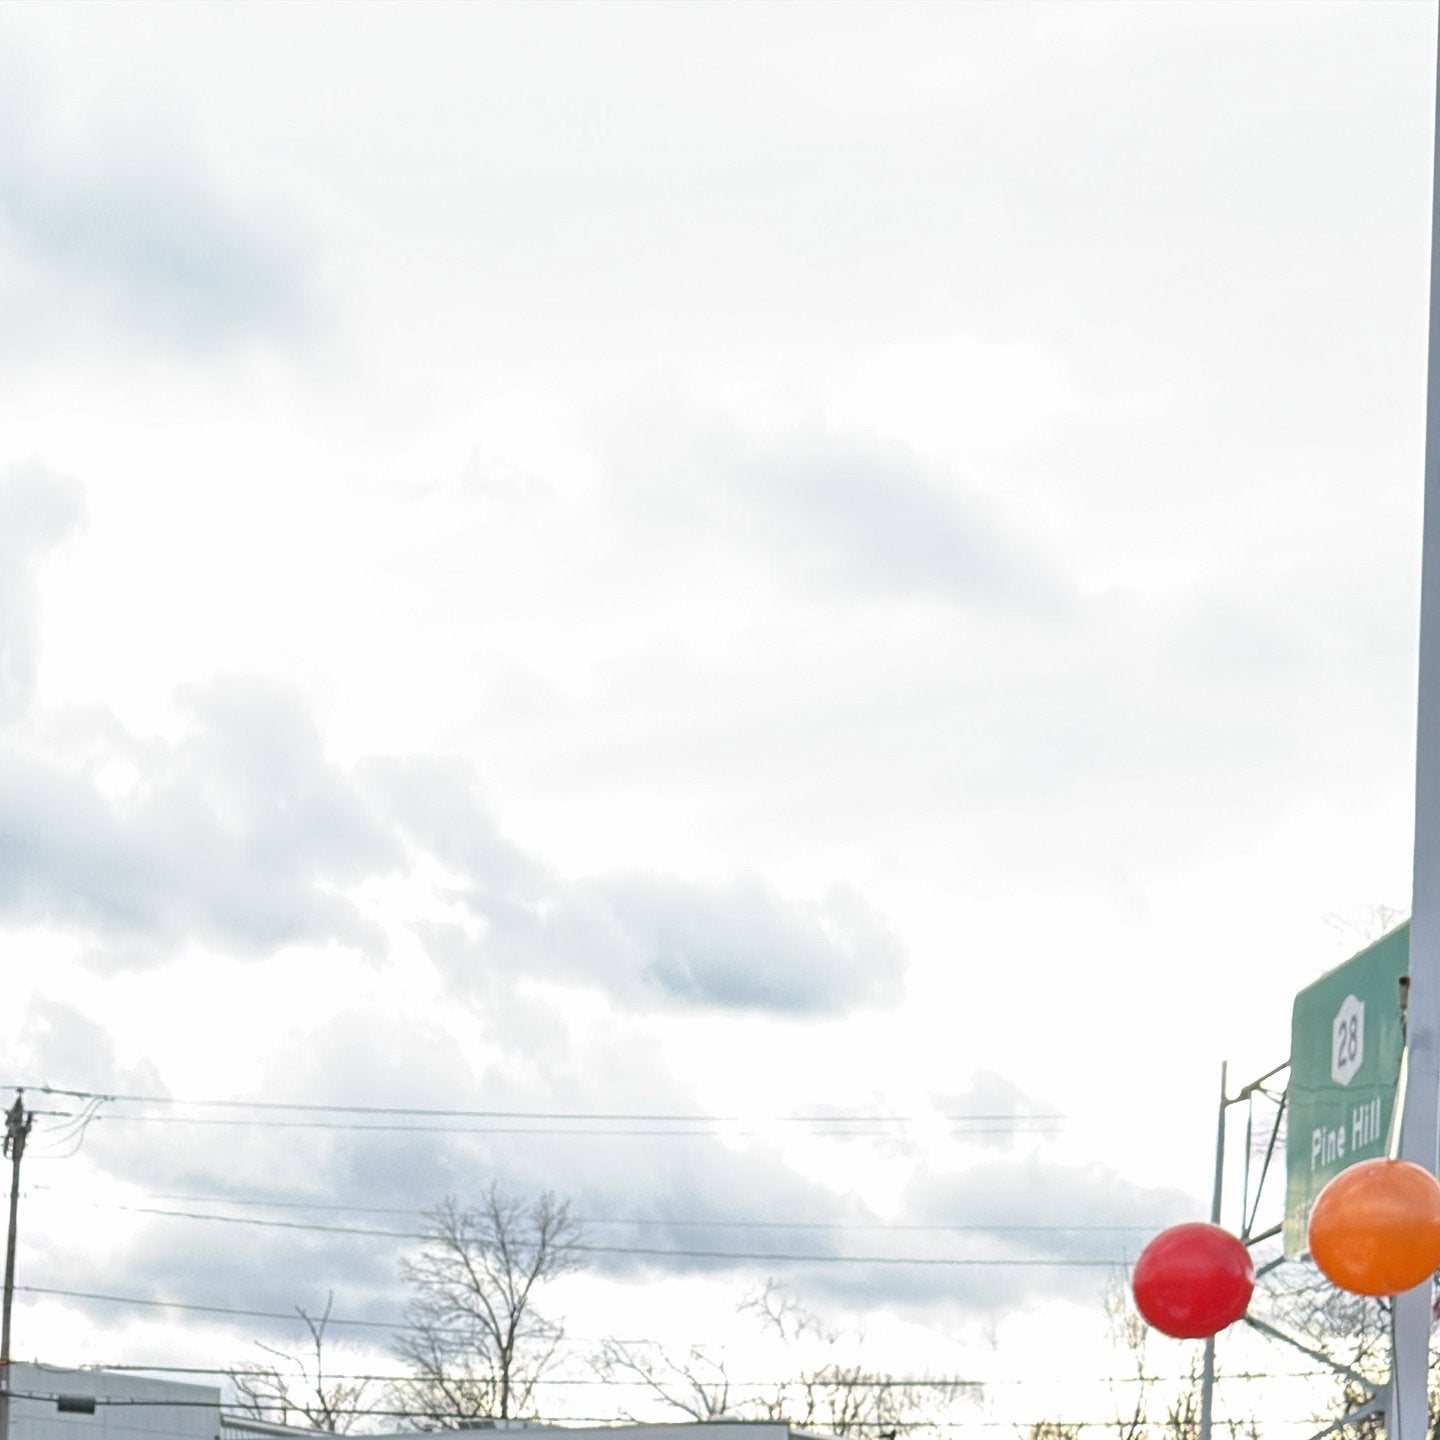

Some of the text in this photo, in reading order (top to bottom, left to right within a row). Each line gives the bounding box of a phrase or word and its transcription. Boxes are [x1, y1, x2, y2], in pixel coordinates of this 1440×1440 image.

[1337, 1014, 1359, 1069] 28
[1311, 1096, 1381, 1171] Pine Hill
